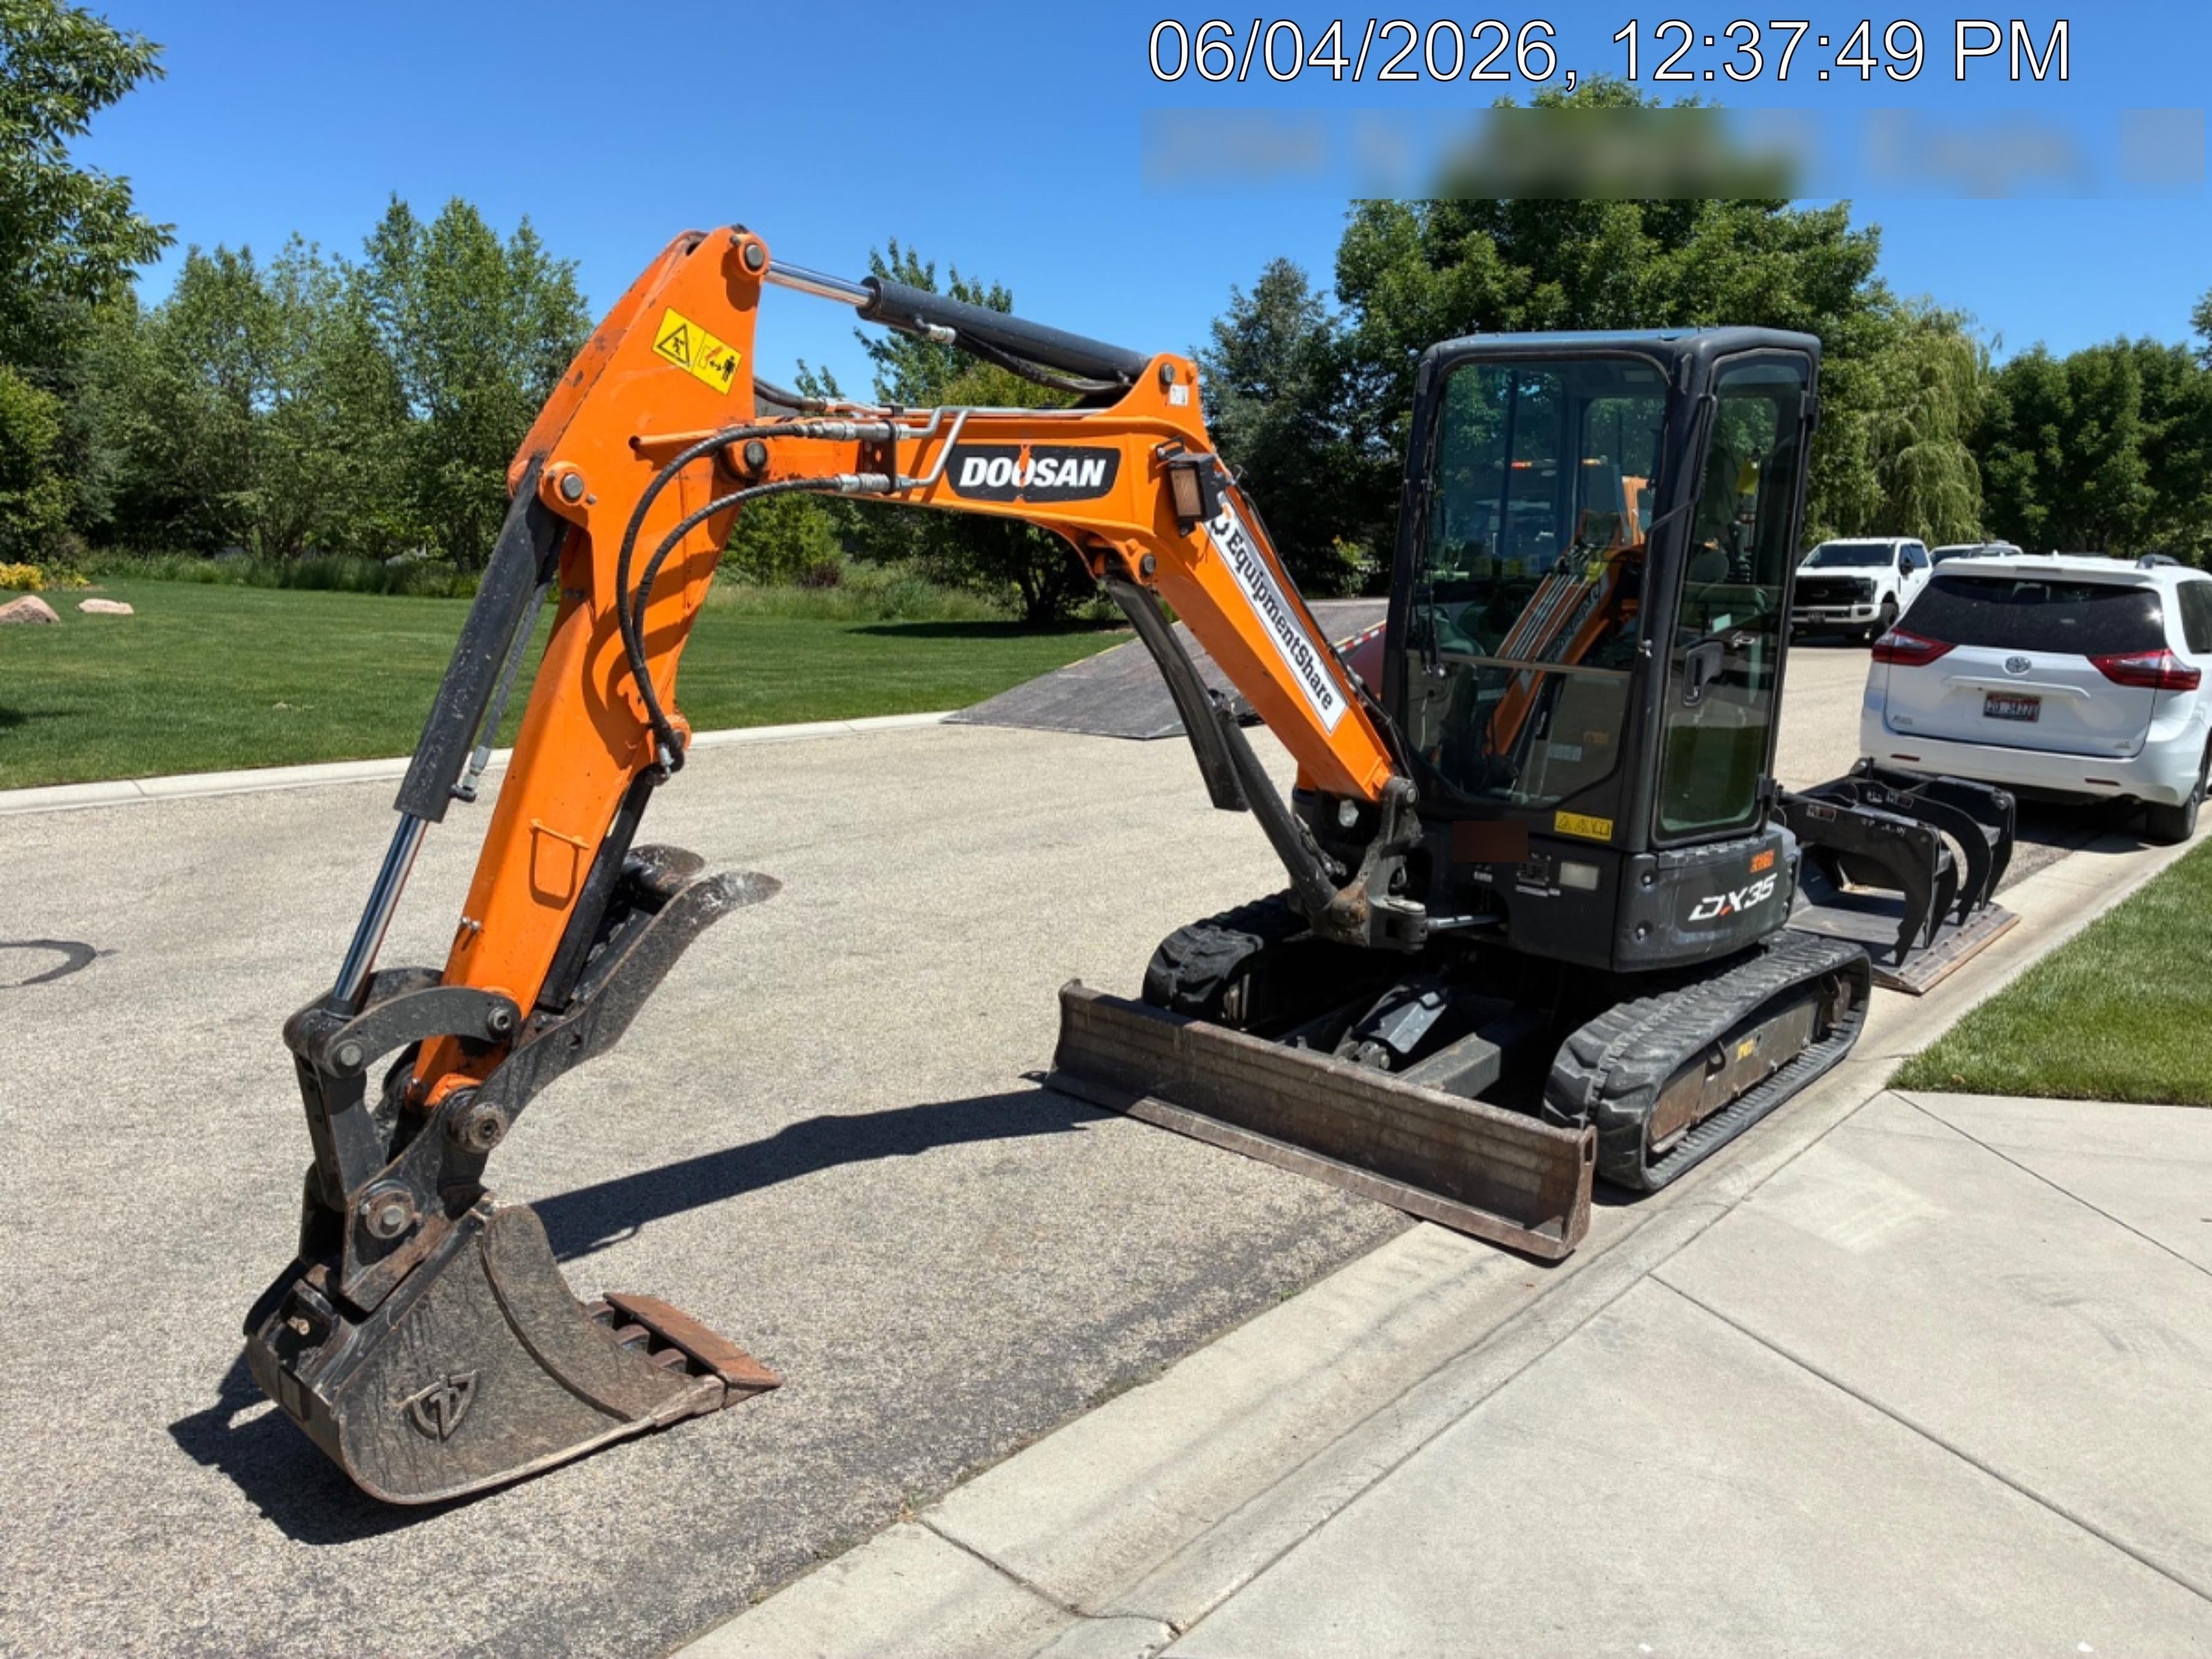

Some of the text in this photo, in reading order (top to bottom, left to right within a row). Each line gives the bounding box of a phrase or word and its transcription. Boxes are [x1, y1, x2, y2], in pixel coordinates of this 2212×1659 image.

[959, 456, 1107, 488] DOOSAN
[1226, 530, 1334, 710] EquipmentShare
[1688, 872, 1778, 921] DX35
